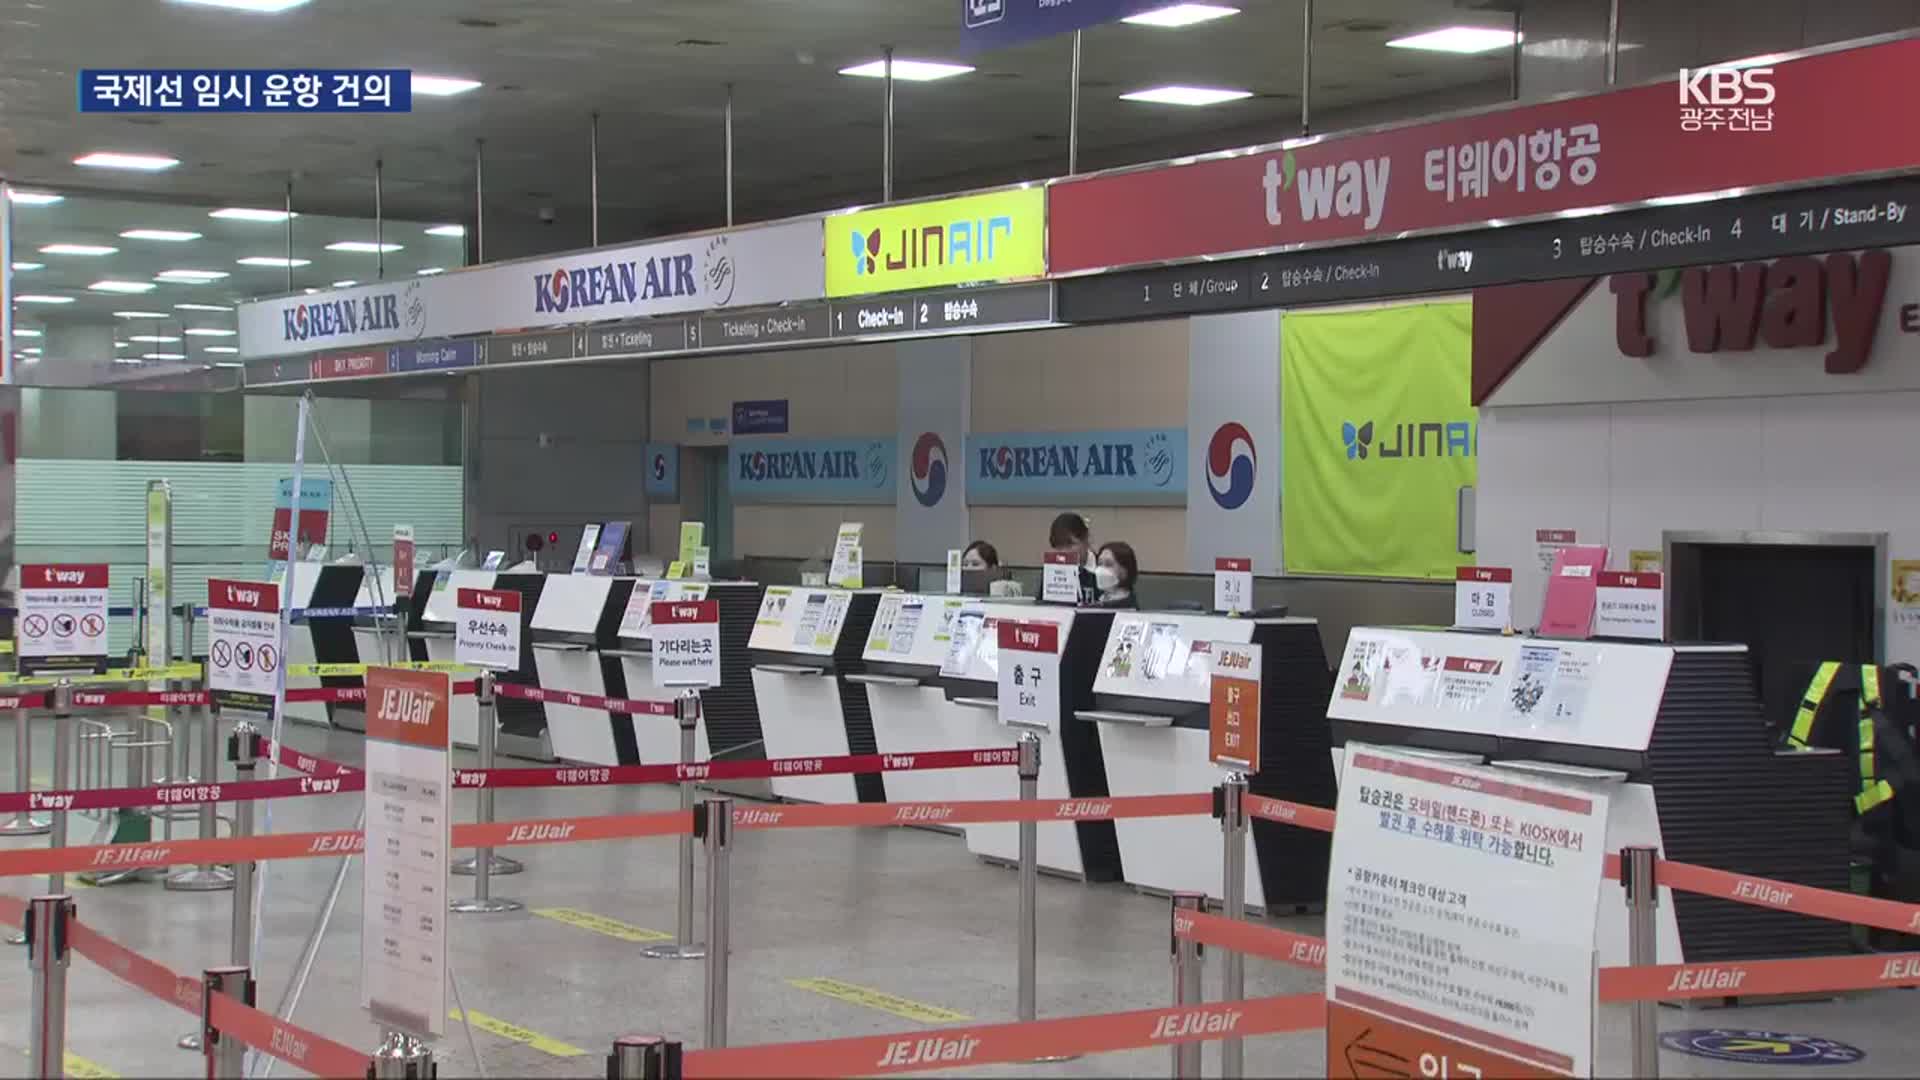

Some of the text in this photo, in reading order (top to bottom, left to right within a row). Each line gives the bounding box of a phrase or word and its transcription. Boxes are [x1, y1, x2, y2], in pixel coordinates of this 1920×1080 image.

[1424, 123, 1601, 203] 티웨이항공
[1262, 151, 1391, 230] t'way
[1730, 217, 1742, 239] 4
[1833, 200, 1907, 226] Stand-By
[1552, 238, 1562, 260] 3
[1580, 230, 1635, 256] 탑승수속
[1651, 223, 1711, 248] Check-In
[533, 261, 637, 313] KOREAN
[641, 253, 698, 300] AIR
[1143, 285, 1151, 302] 1
[1260, 272, 1270, 291] 2
[283, 292, 400, 342] KOREAN AIR
[836, 311, 843, 331] 1
[920, 299, 979, 323] 2 탑승수속
[739, 450, 859, 482] KOREAN AIR
[980, 444, 1135, 480] KOREAN AIR
[45, 567, 85, 585] t'way
[226, 584, 261, 608] t'way
[468, 619, 508, 637] 우선수속
[659, 638, 712, 653] 기다리는곳
[378, 686, 436, 726] JEJUair
[1018, 691, 1037, 707] Exit
[29, 791, 74, 811] t'way
[157, 785, 222, 803] 티웨이항공
[301, 775, 340, 794] t'way
[555, 768, 611, 783] 티웨이항공
[883, 754, 915, 769] t'way
[92, 847, 170, 865] JEJUair
[506, 823, 576, 842] JEJUair
[895, 806, 954, 821] JEJUair
[1056, 801, 1113, 817] JEJUair
[1359, 785, 1405, 812] 탑승권은
[1490, 814, 1513, 835] 또는
[1519, 821, 1583, 853] KIOSK에서
[1379, 810, 1555, 867] 발권 후 수하물 위탁 가능합니다.
[1731, 879, 1793, 905] JEJUair
[1667, 968, 1747, 992] JEJUair
[876, 1008, 1243, 1069] JEJUair JEJUair
